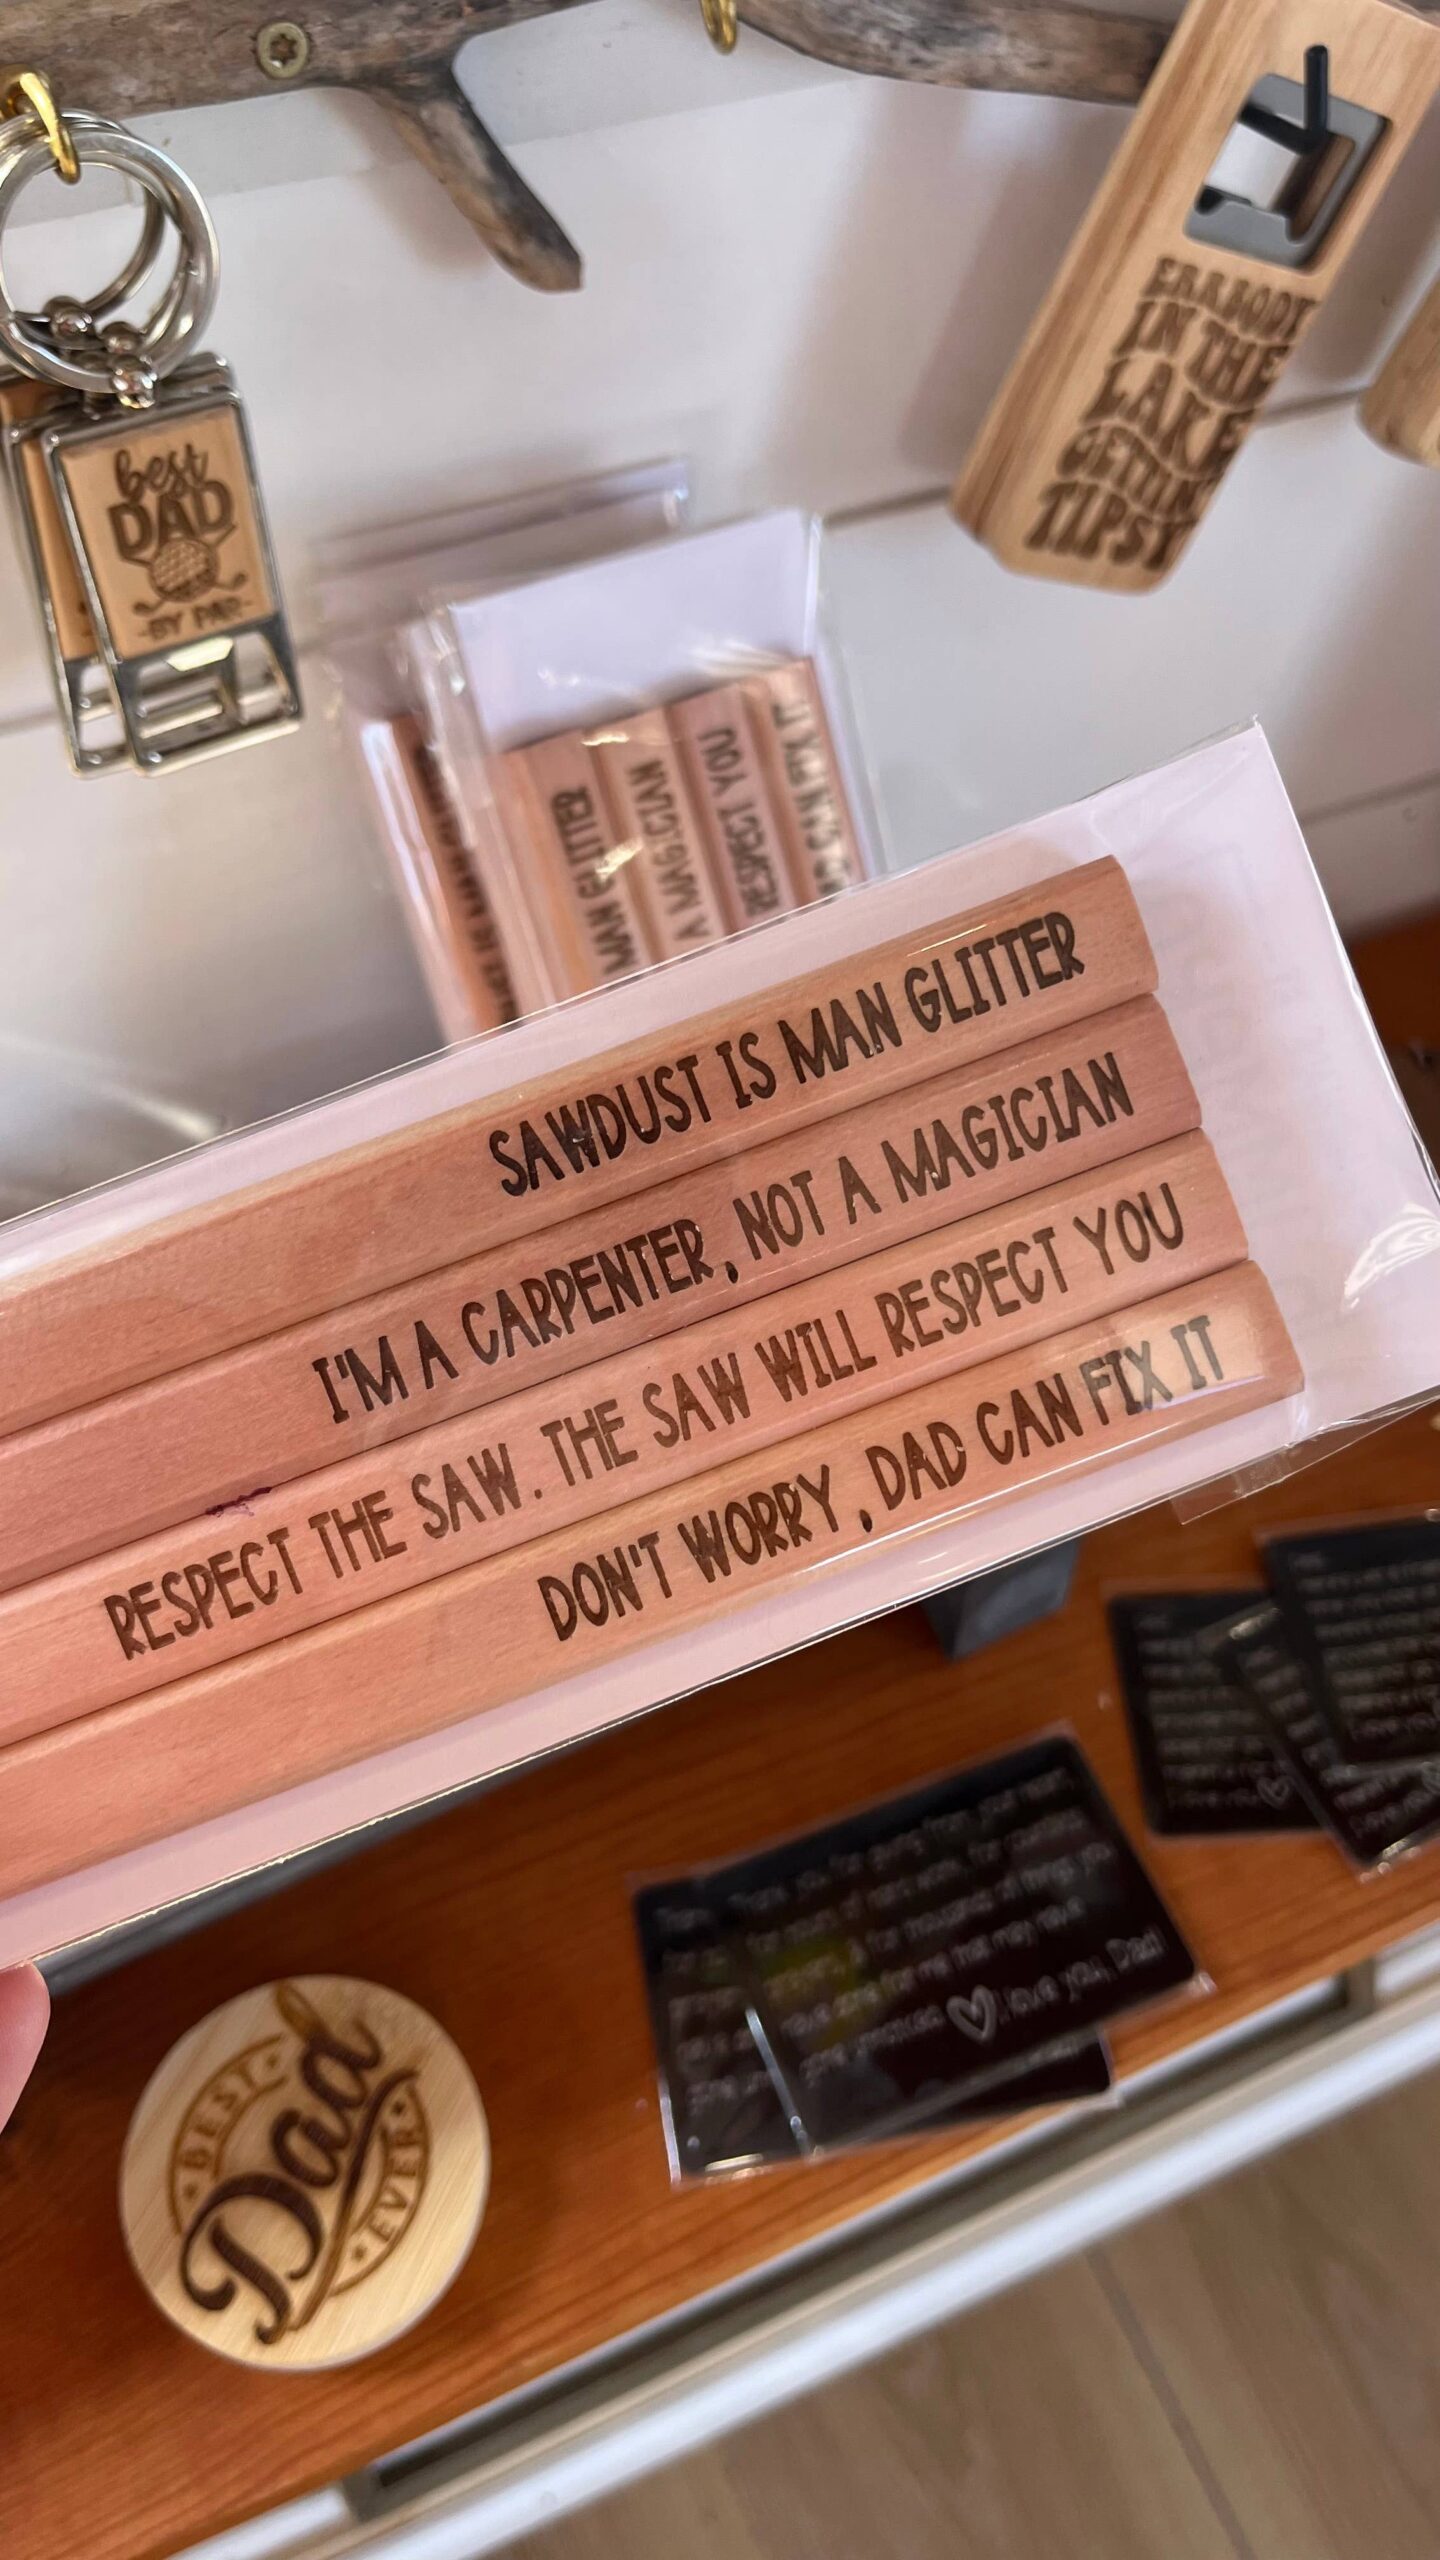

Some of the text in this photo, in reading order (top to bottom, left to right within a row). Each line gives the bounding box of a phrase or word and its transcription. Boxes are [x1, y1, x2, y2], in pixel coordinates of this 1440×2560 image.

[1112, 301, 1291, 407] IN THE
[1082, 357, 1256, 478] LAKE
[106, 479, 234, 558] DAD
[697, 726, 747, 795] YOU
[489, 911, 1086, 1199] SAWDUST IS MAN GLITTER
[312, 1334, 409, 1424] I'M
[413, 1319, 460, 1390] A
[733, 1170, 824, 1262] NOT
[839, 1157, 880, 1225] A
[881, 1052, 1136, 1205] MAGICIAN
[103, 1527, 303, 1661] RESPECT
[309, 1490, 408, 1579] THE
[539, 1399, 638, 1488] THE
[642, 1352, 752, 1449] SAW
[755, 1303, 877, 1403] WILL
[875, 1226, 1070, 1359] RESPECT
[1072, 1182, 1185, 1277] YOU
[536, 1530, 673, 1643] DON'T
[864, 1419, 968, 1512] DAD
[976, 1371, 1085, 1467] CAN
[1078, 1339, 1174, 1428] FIX
[1169, 1313, 1226, 1391] IT
[177, 2058, 262, 2172] BEST
[180, 1978, 392, 2346] Dad
[366, 2120, 426, 2244] EVER
